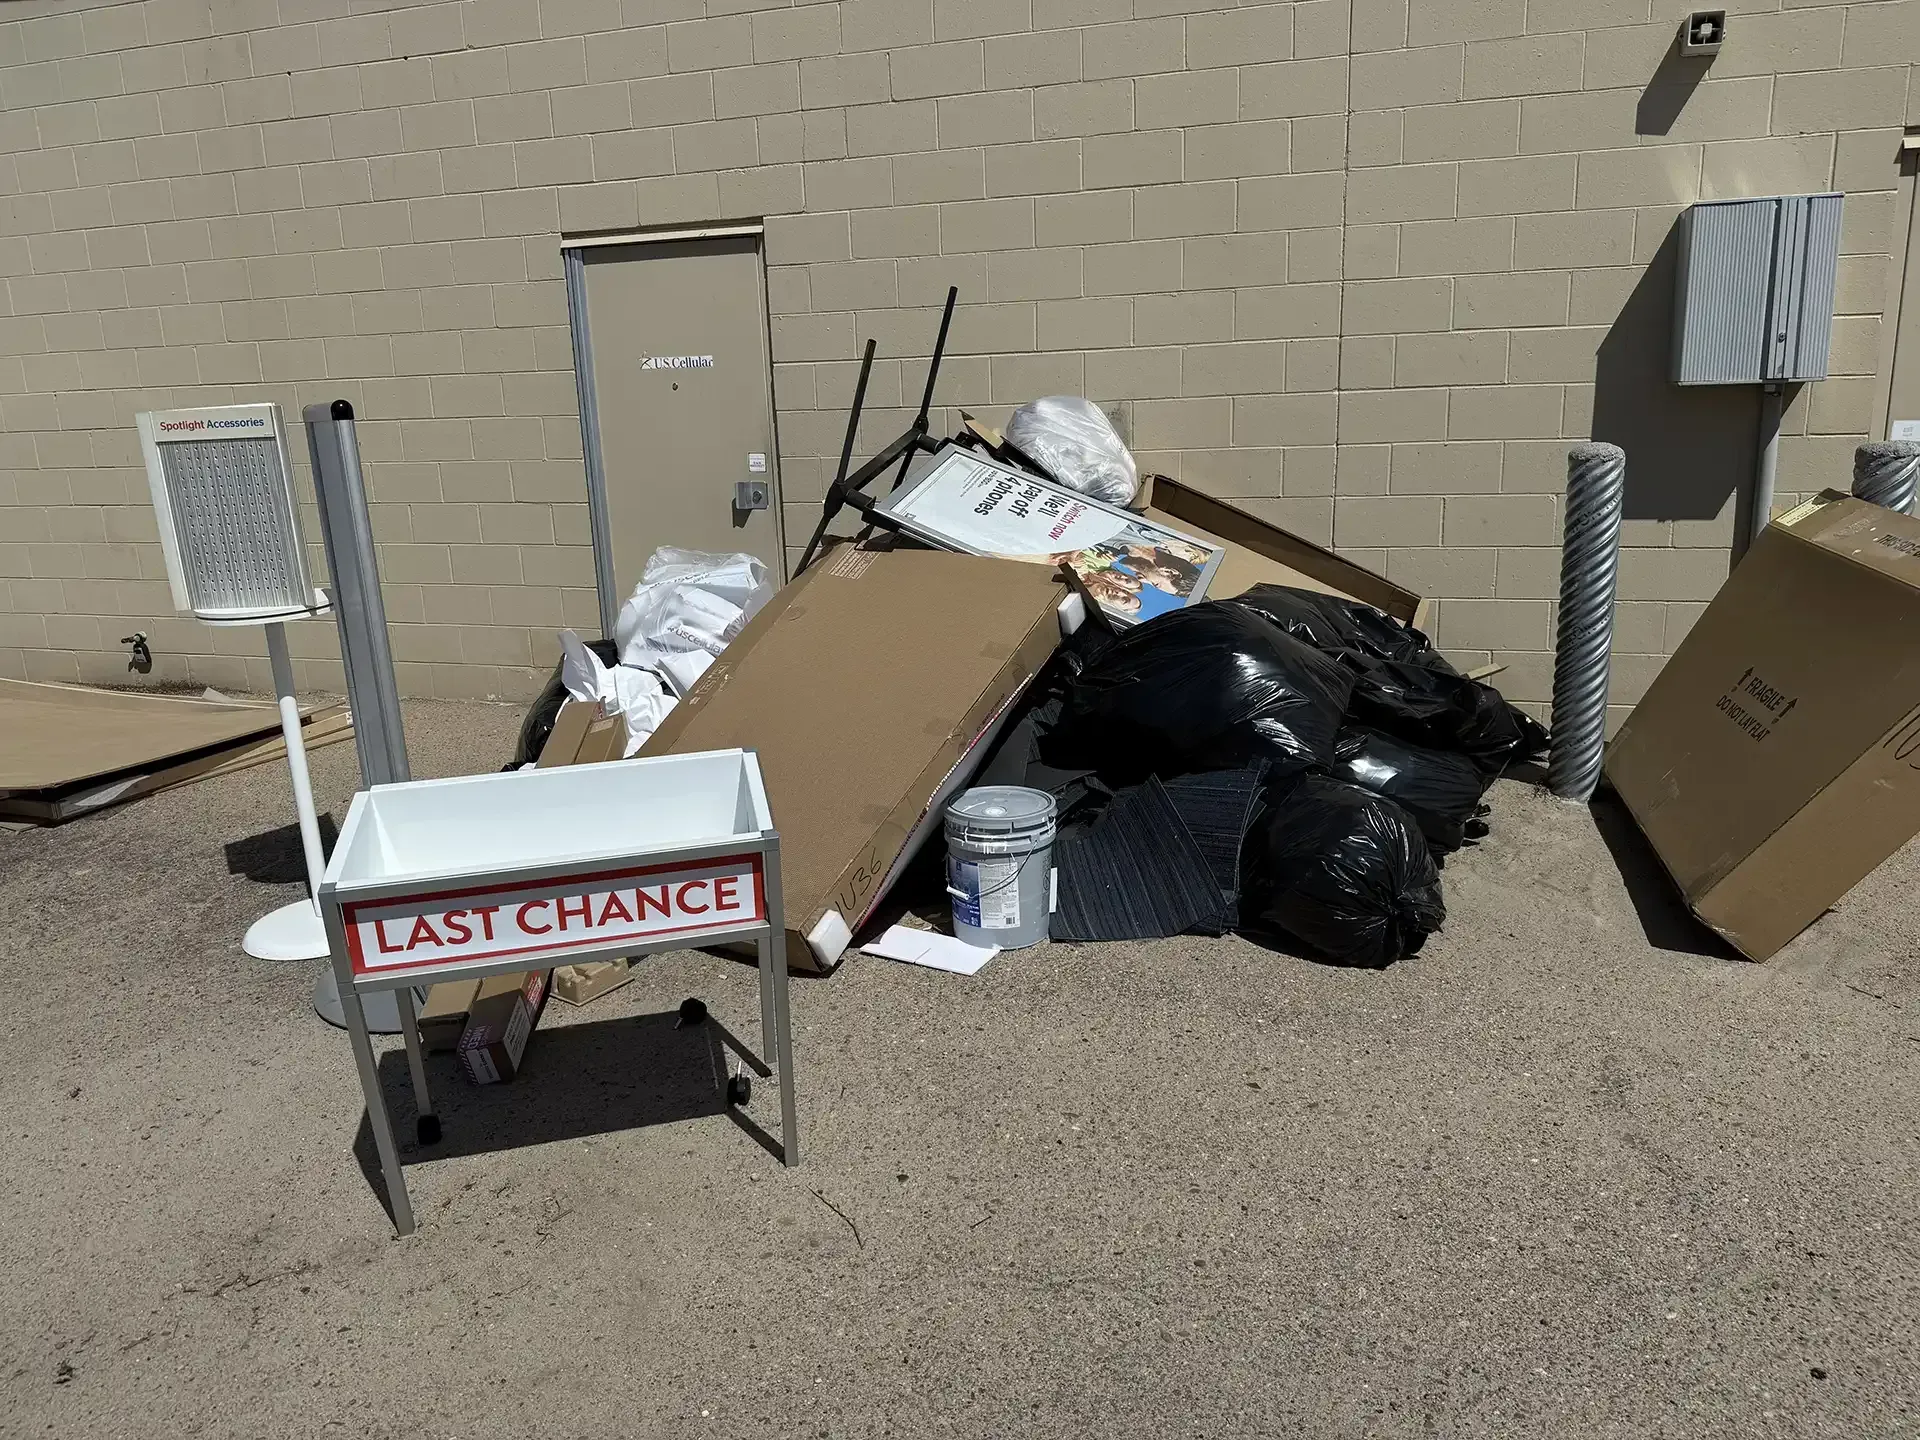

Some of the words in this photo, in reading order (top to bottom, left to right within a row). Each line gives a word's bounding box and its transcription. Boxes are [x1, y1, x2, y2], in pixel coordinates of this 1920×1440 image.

[160, 421, 205, 432] Spotlight
[206, 418, 264, 429] Accessories
[1004, 477, 1021, 486] 4
[974, 480, 1013, 516] phones
[1017, 484, 1043, 502] pay
[1008, 500, 1029, 518] off
[1037, 495, 1070, 518] We'll
[1060, 503, 1087, 524] Switch
[1048, 522, 1067, 540] now
[1716, 694, 1732, 711] DO
[1744, 677, 1785, 712] FRAGILE
[1725, 702, 1746, 721] NOT
[1737, 713, 1758, 731] LAY
[1747, 722, 1771, 743] FLAT
[375, 905, 500, 954] LAST
[516, 876, 741, 936] CHANCE
